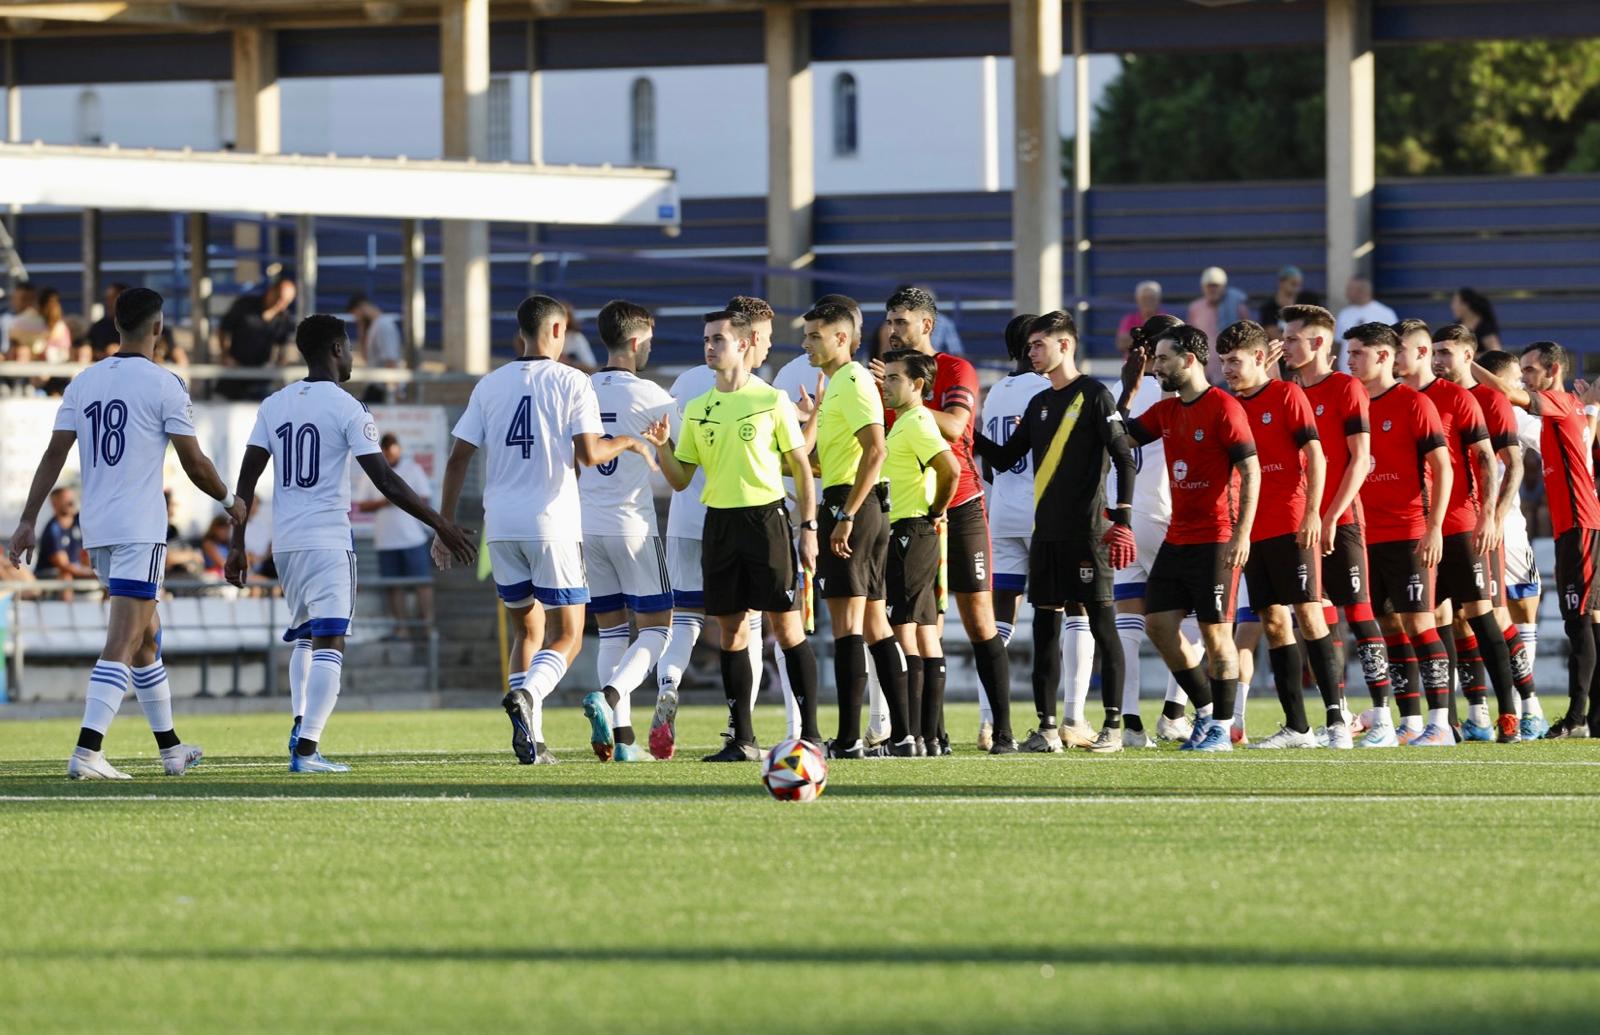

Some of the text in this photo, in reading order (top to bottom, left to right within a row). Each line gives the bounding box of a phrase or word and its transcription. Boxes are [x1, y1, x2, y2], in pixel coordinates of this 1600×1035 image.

[83, 399, 128, 468] 18
[505, 395, 534, 459] 4
[275, 421, 320, 488] 10
[975, 562, 985, 580] 5
[1299, 574, 1308, 591] 7
[1351, 576, 1361, 594] 9
[1475, 572, 1485, 590] 4
[1406, 584, 1424, 601] 17
[1565, 593, 1579, 610] 19
